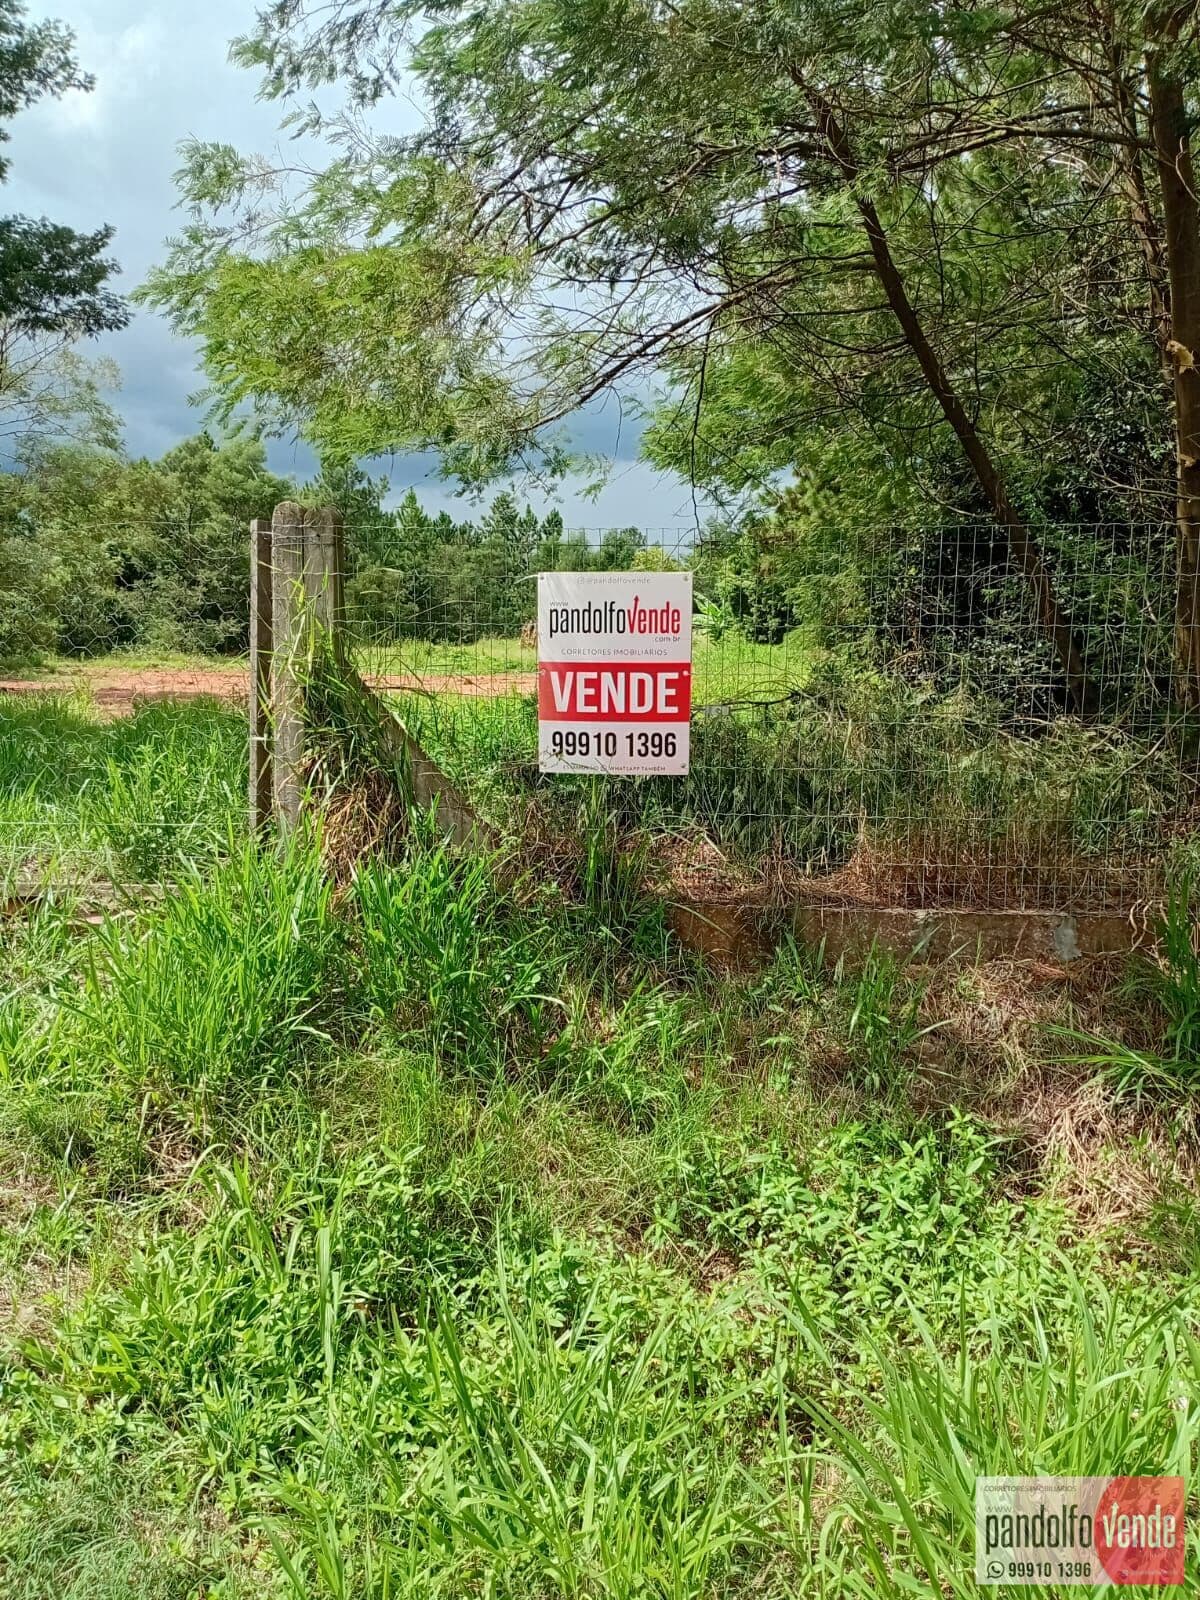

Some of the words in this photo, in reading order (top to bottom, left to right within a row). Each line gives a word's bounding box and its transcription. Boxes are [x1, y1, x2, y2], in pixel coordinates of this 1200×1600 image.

[560, 648, 612, 656] CORRETORES
[550, 671, 679, 714] VENDE
[552, 731, 617, 757] 99910
[625, 732, 677, 758] 1396
